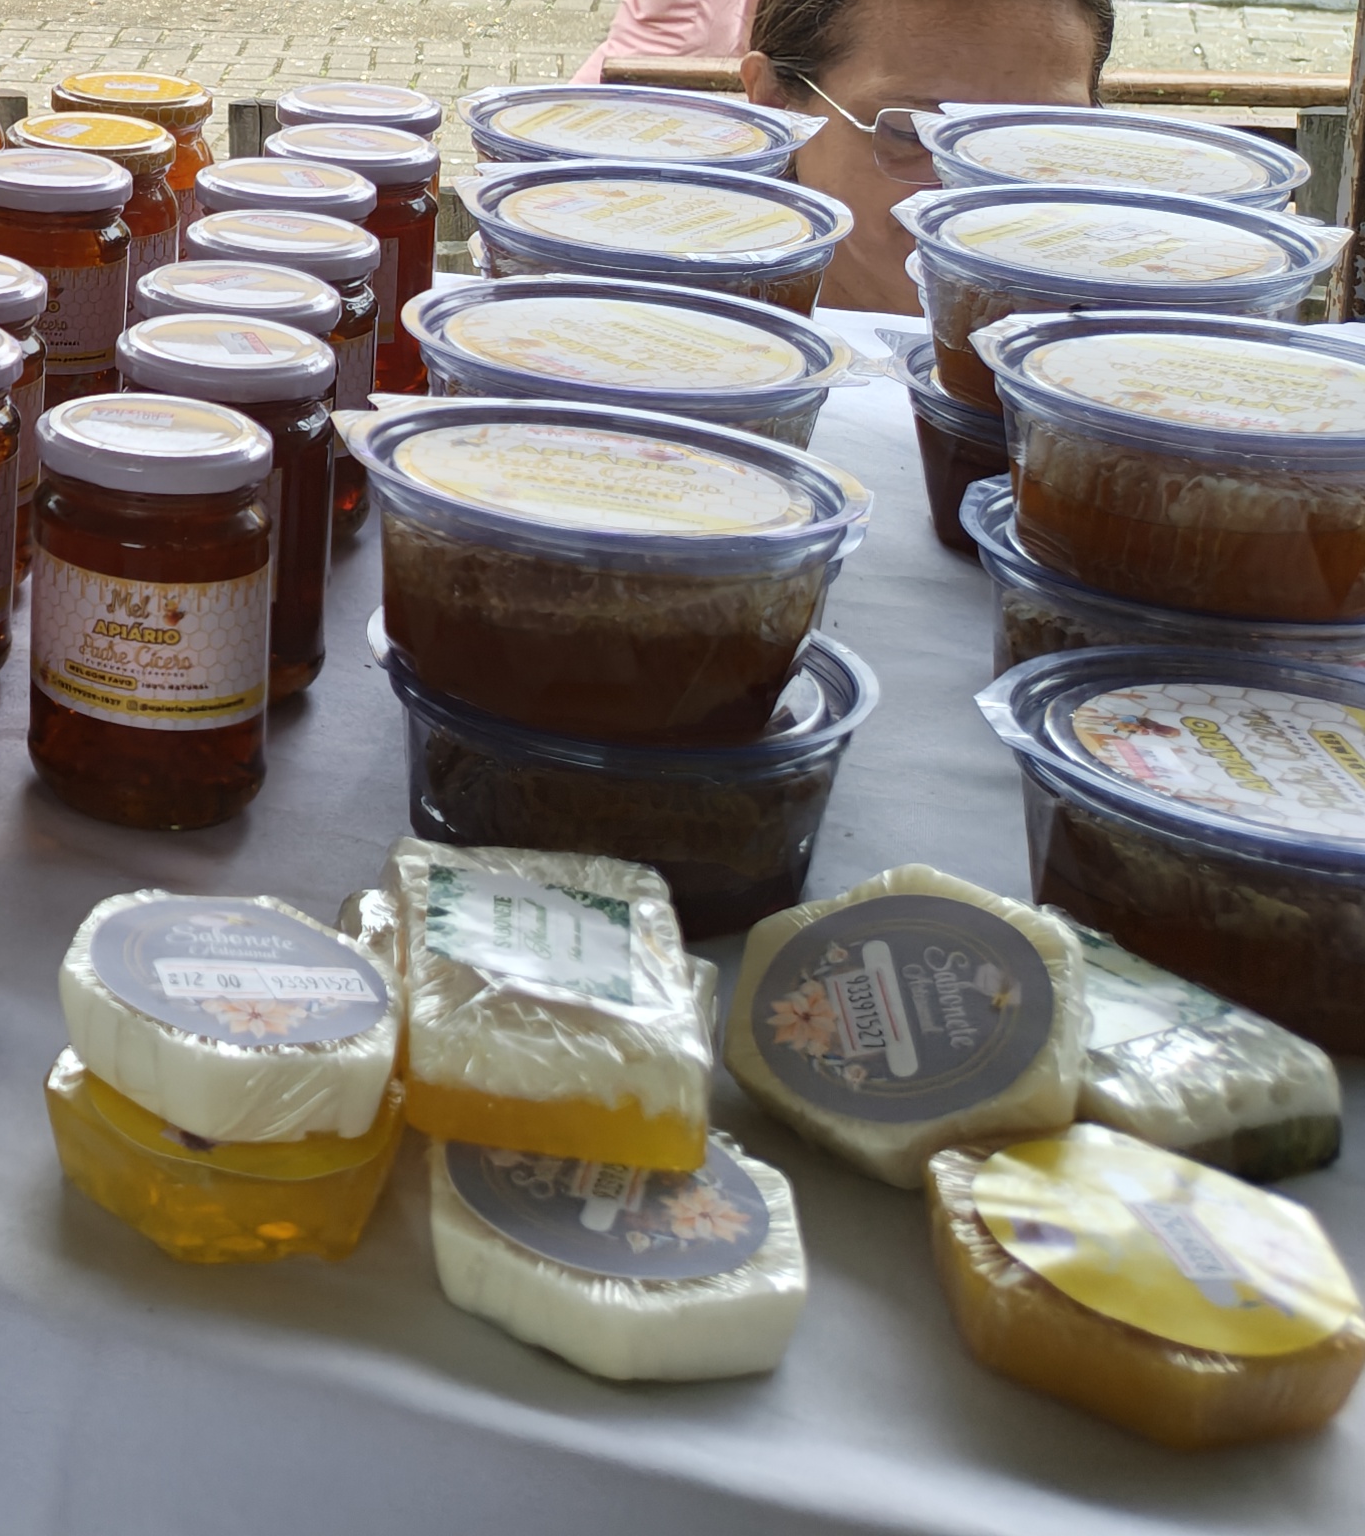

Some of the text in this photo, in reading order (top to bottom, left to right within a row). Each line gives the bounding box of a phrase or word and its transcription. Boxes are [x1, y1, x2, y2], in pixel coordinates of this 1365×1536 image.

[106, 589, 151, 620] Mel
[93, 619, 182, 646] APIÁRIO
[79, 633, 132, 667] Padre
[165, 923, 297, 953] Sabonete
[271, 974, 366, 994] 93391527
[922, 944, 979, 1051] Sabonete
[846, 974, 887, 1051] 93391527
